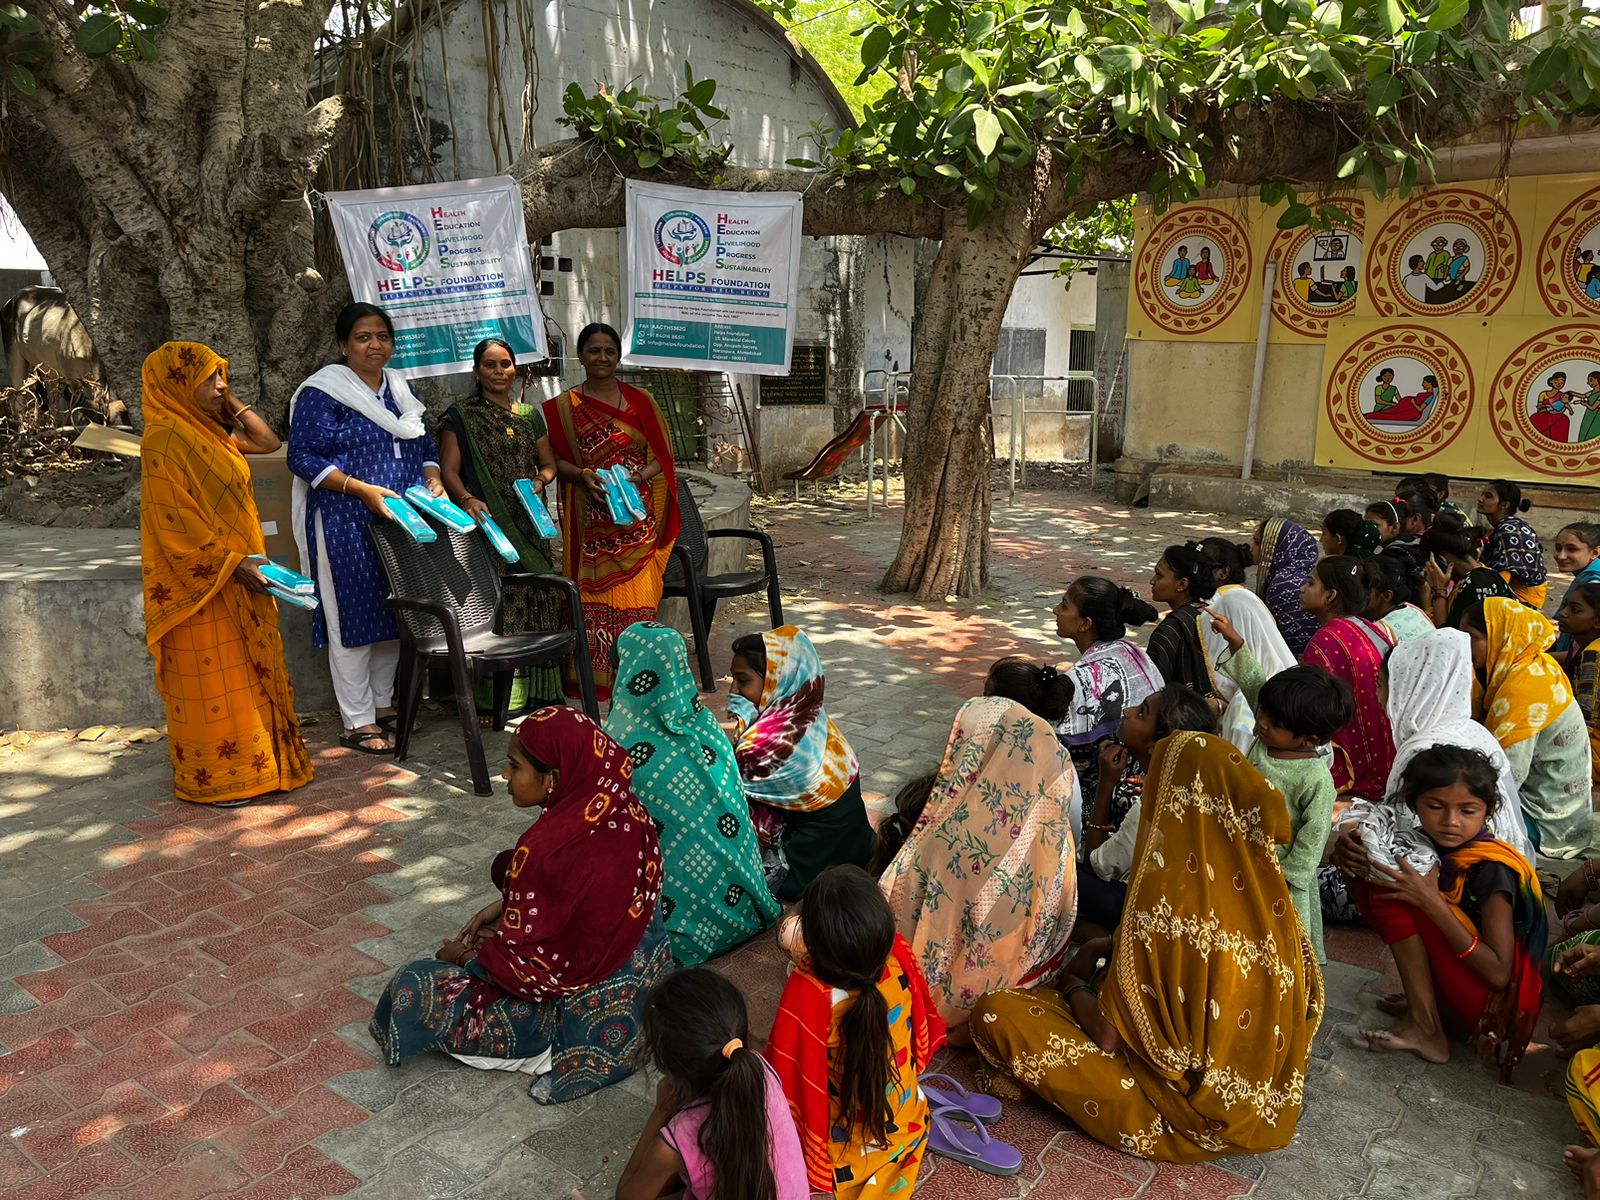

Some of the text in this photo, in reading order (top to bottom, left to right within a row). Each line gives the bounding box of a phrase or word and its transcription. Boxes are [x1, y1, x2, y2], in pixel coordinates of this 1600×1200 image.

[434, 219, 481, 231] EDUCATION
[717, 213, 749, 225] HEALTH
[717, 224, 760, 235] EDUCATION
[435, 232, 484, 243] LIVELIHOOD
[716, 235, 761, 248] LIVELIHOOD
[438, 244, 482, 256] PROGRESS
[716, 246, 756, 260] PROGRESS
[440, 257, 501, 269] SUSTAINABILITY
[715, 257, 772, 273] SUSTAINABILITY
[377, 272, 504, 292] HELPS FOUNDATION
[653, 269, 771, 290] HELPS FOUNDATION
[711, 286, 769, 297] WELL-BEING
